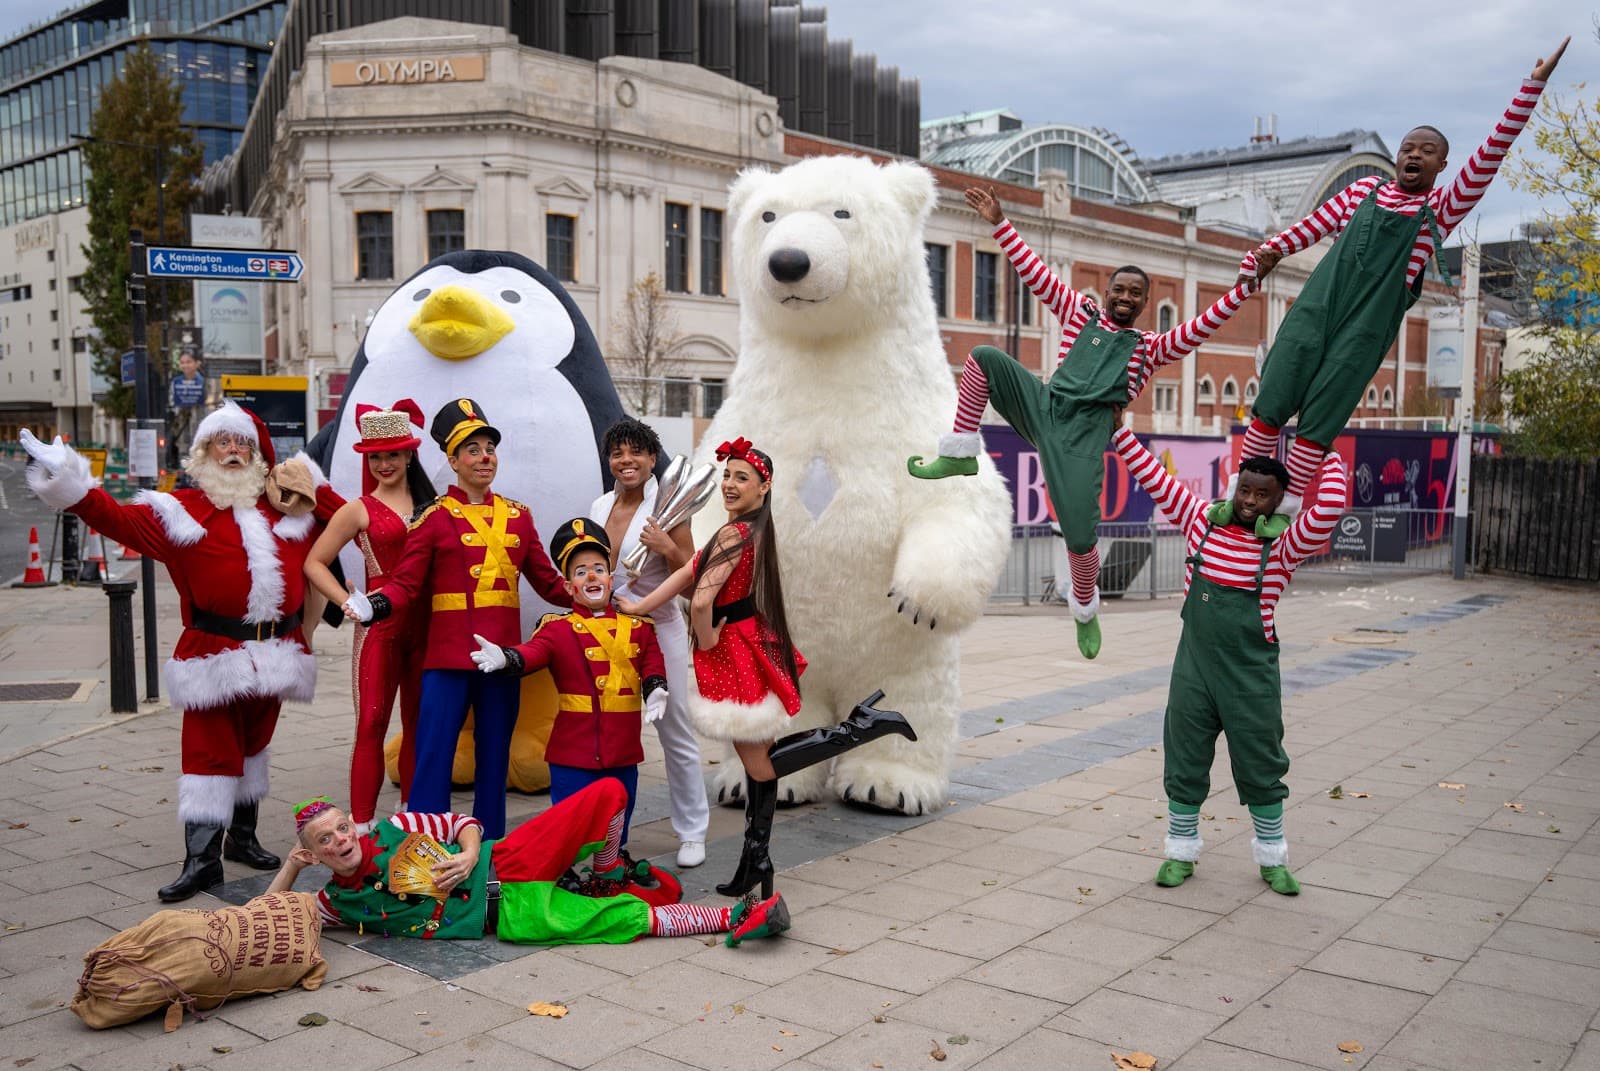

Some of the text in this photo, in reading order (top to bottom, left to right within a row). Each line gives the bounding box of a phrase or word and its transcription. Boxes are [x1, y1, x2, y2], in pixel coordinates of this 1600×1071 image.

[355, 59, 456, 83] OLYMPIA
[169, 253, 222, 264] Kensington
[169, 262, 246, 273] Olympia Station
[1336, 535, 1364, 545] Cyclists
[251, 910, 268, 921] IN
[249, 923, 270, 968] MADE
[270, 914, 290, 965] NORTH
[291, 948, 305, 965] BY
